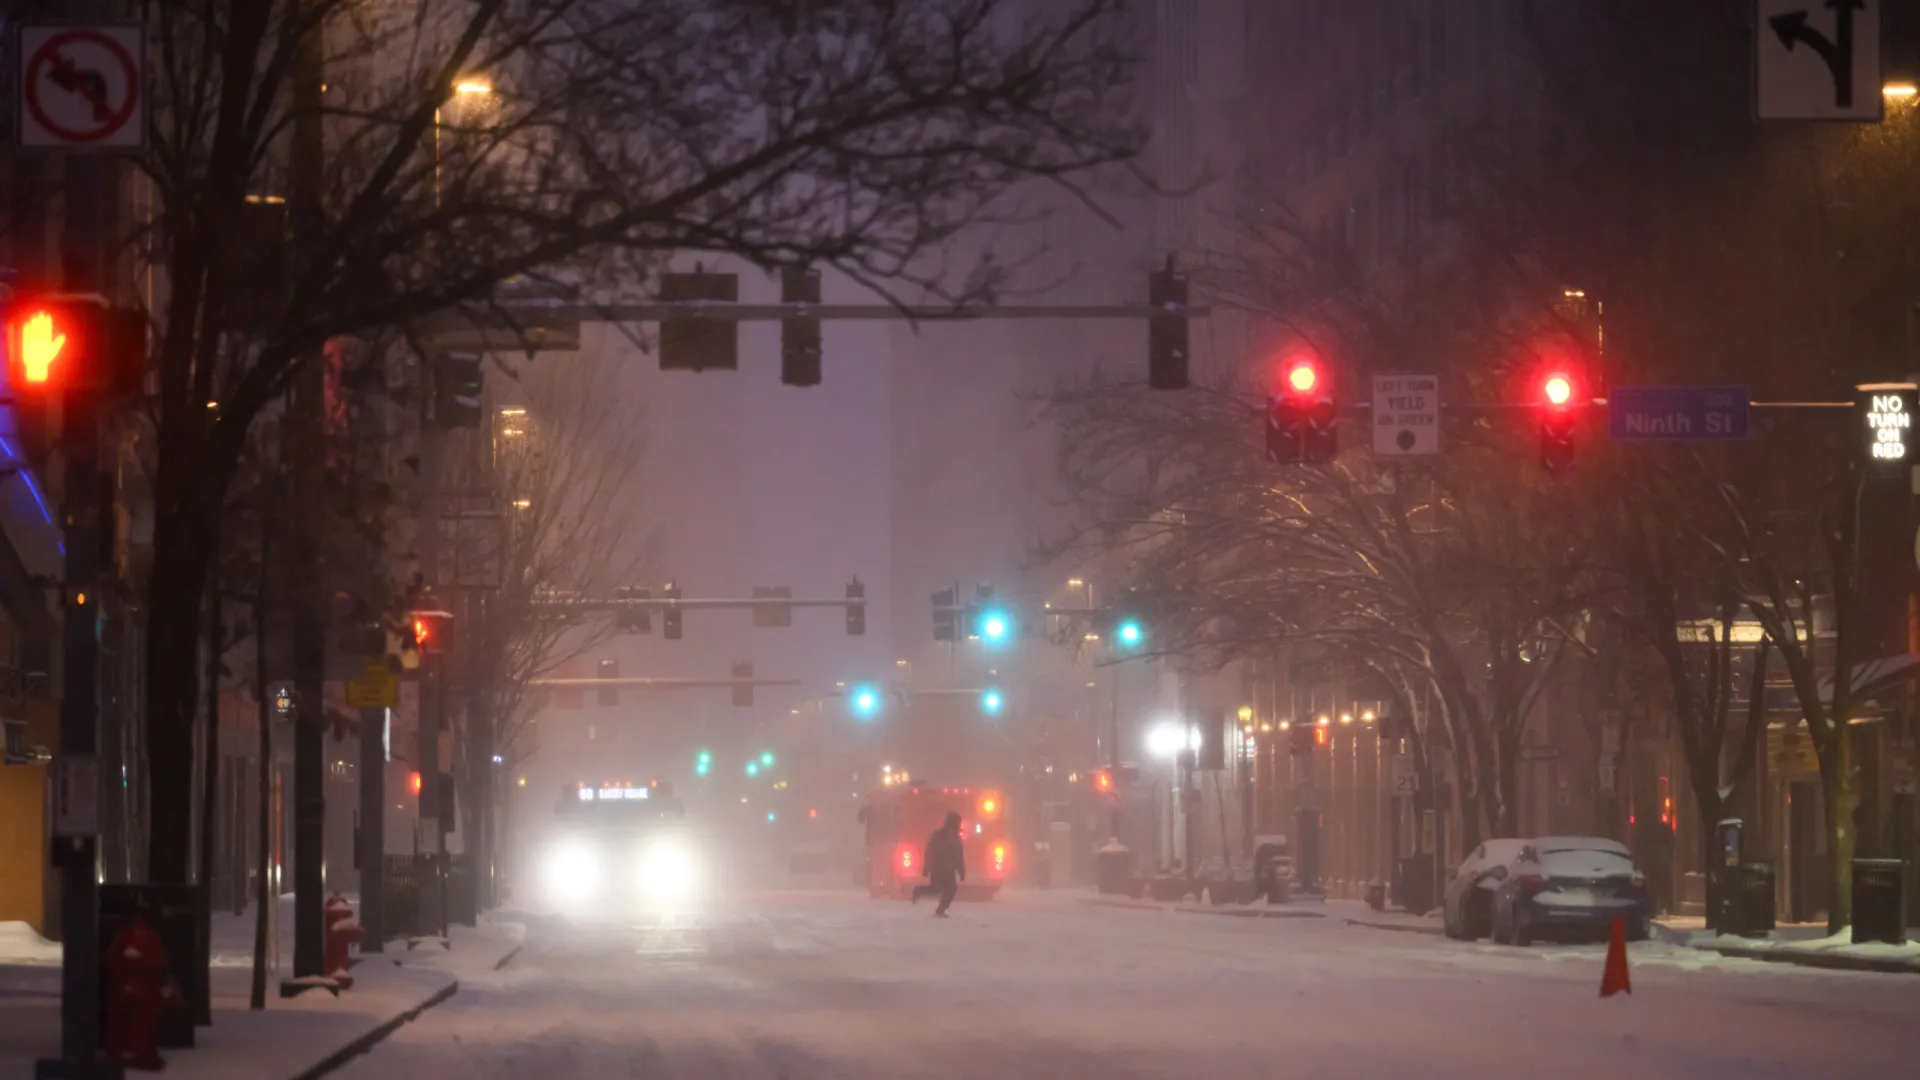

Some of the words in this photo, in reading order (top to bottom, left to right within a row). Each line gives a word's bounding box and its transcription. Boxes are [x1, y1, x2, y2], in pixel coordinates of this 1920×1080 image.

[1388, 396, 1425, 411] YIELD
[1872, 395, 1903, 413] NO
[1625, 411, 1691, 434] Ninth
[1704, 411, 1733, 434] St
[1866, 412, 1910, 428] TURN
[1877, 427, 1901, 443] ON
[1872, 442, 1906, 459] RED
